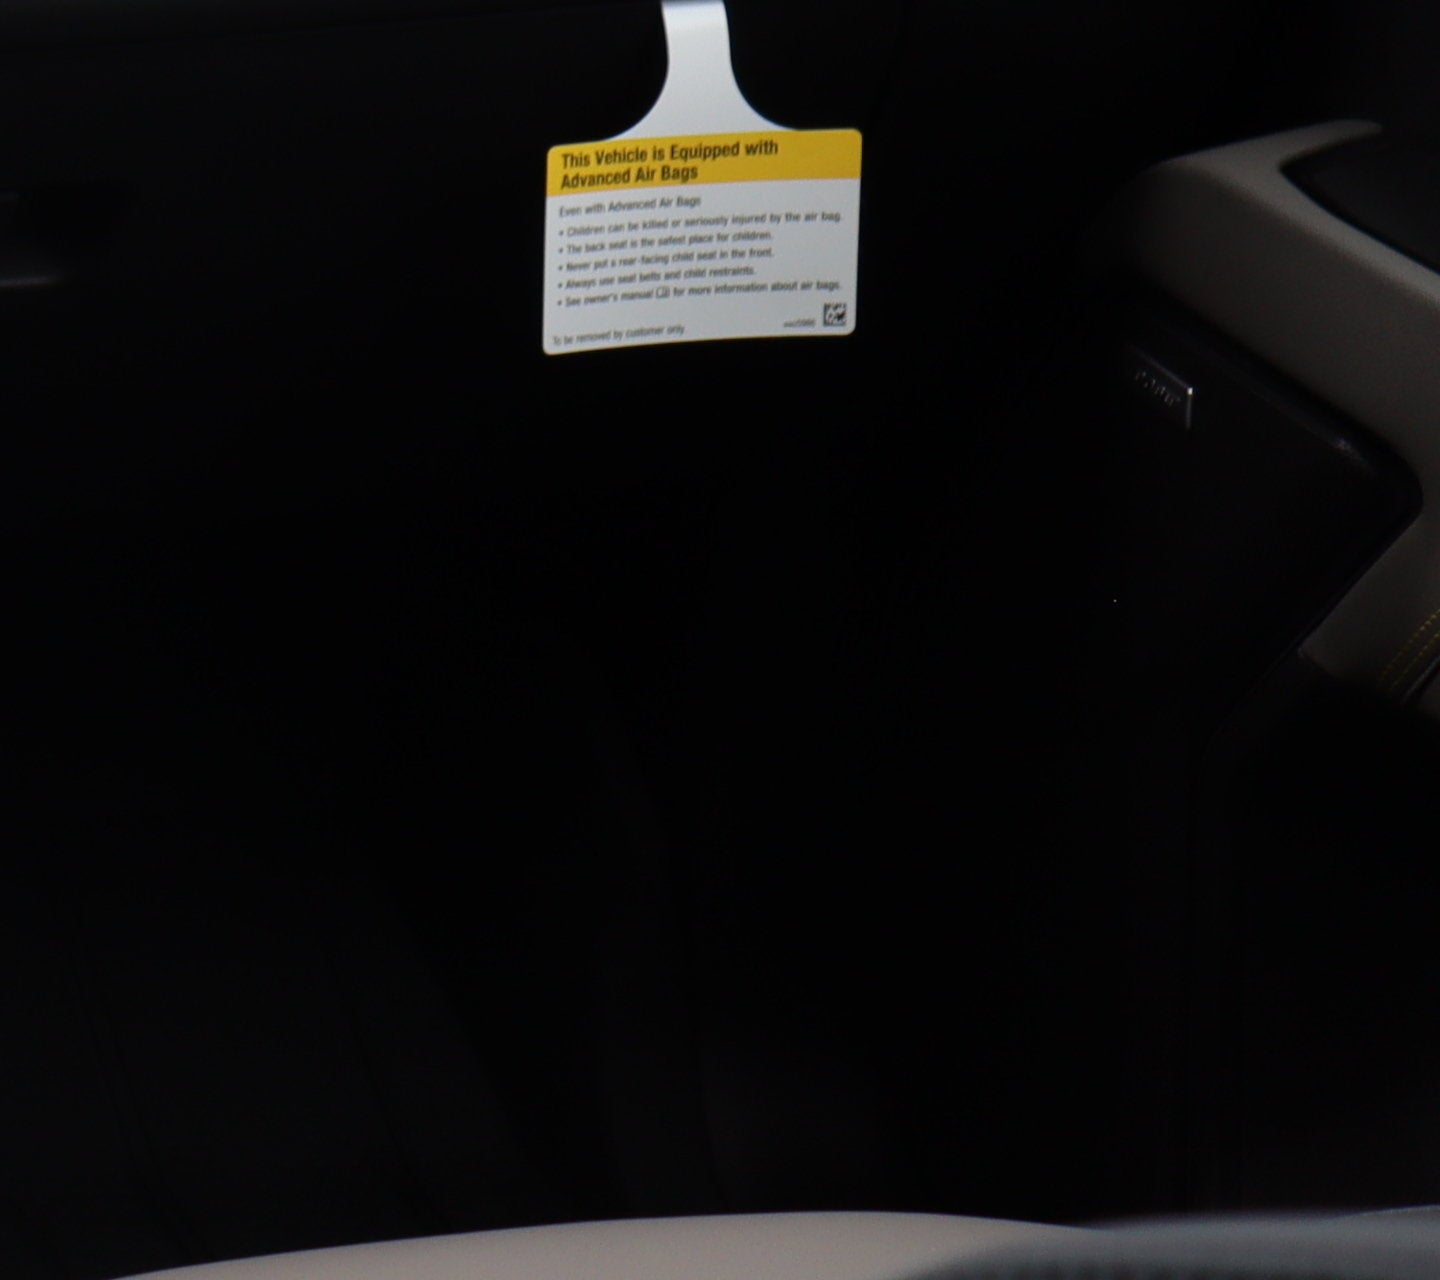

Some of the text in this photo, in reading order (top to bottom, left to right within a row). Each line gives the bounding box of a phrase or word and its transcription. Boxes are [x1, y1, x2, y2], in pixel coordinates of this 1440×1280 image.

[561, 139, 778, 169] This Vehicle is Equipped with
[559, 163, 698, 189] Advanced Air Bags
[559, 195, 701, 217] Even with Advanced Air Bags
